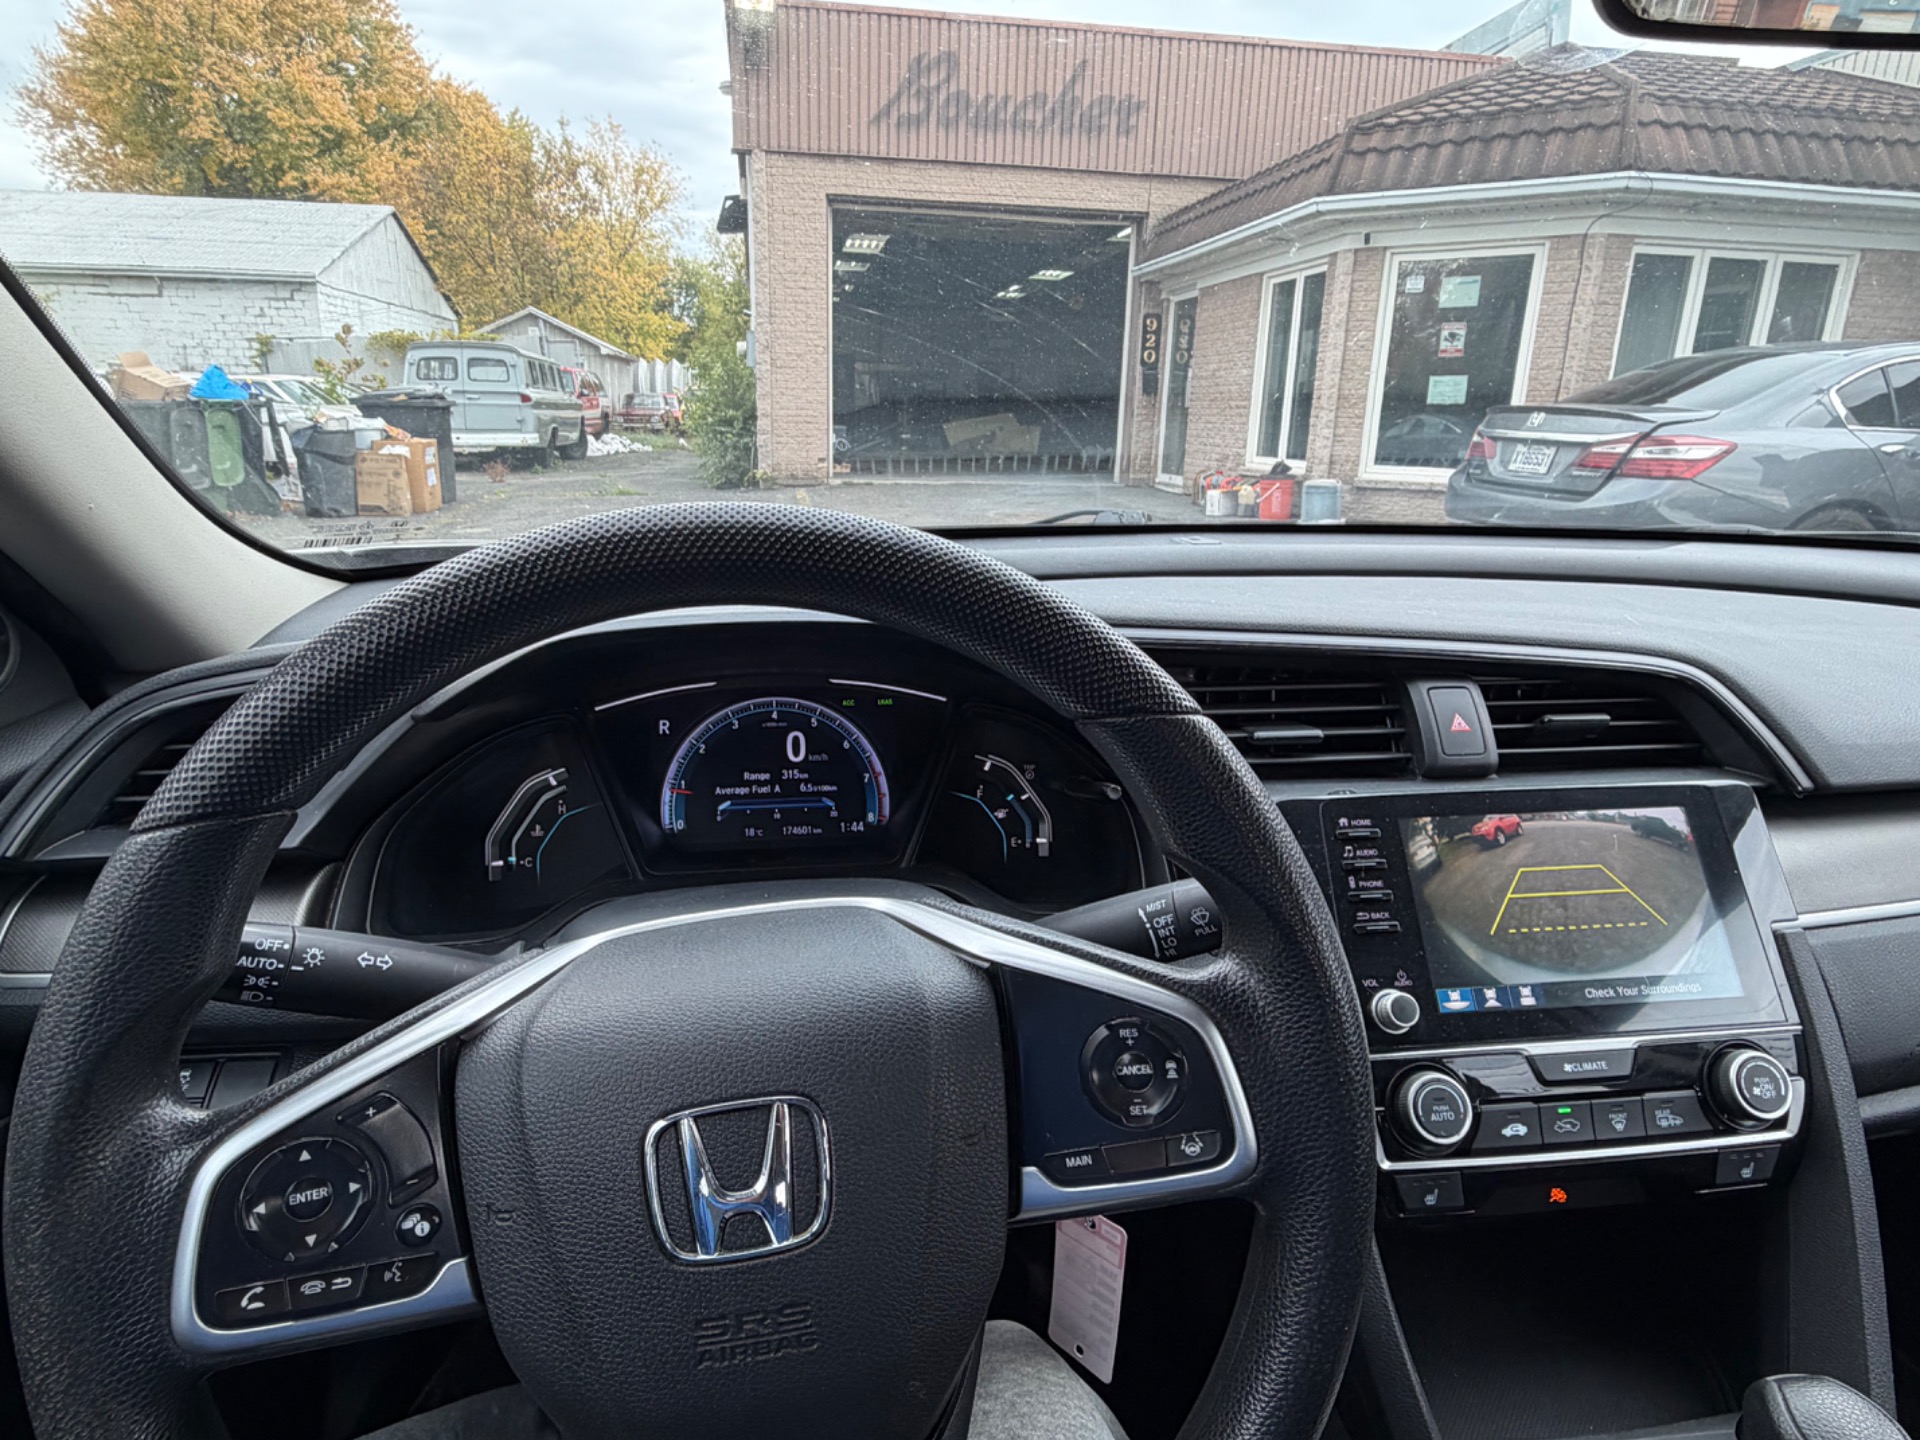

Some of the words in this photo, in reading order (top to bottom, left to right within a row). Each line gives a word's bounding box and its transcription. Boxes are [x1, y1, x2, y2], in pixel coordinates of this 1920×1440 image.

[870, 51, 1147, 137] Boucher
[1143, 317, 1159, 364] 920
[878, 698, 893, 706] LKAS
[771, 710, 778, 720] 4
[659, 719, 670, 735] R
[732, 720, 739, 730] 3
[810, 718, 818, 728] 5
[699, 744, 706, 754] 2
[786, 730, 806, 763] 0
[808, 753, 829, 761] km/h
[843, 740, 850, 749] 6
[743, 771, 771, 781] Range
[863, 773, 870, 783] 7
[680, 780, 685, 789] 1
[715, 786, 750, 796] Average
[752, 784, 771, 794] Fuel
[774, 783, 781, 793] A
[558, 804, 567, 815] H
[773, 812, 781, 820] 10
[867, 812, 875, 822] 8
[677, 820, 684, 830] 0
[840, 821, 864, 832] 1:44
[1351, 819, 1372, 827] HOME
[745, 828, 755, 837] 18
[782, 826, 812, 835] 174601
[1011, 837, 1018, 847] E
[1356, 848, 1378, 856] AUDIO
[525, 857, 533, 868] C
[1359, 880, 1384, 888] PHONE
[1146, 899, 1167, 913] MIST
[1153, 914, 1174, 928] OFF
[1157, 925, 1176, 938] INT
[1194, 924, 1218, 937] PULL
[255, 938, 284, 951] OFF
[1161, 937, 1177, 949] LO
[1163, 949, 1177, 958] HI
[236, 956, 277, 970] AUTO
[1361, 979, 1379, 988] VOL
[1585, 986, 1616, 998] Check
[1616, 985, 1639, 996] Your
[1641, 982, 1702, 995] Surroundings
[1119, 1028, 1138, 1038] RES
[1116, 1063, 1153, 1075] CANCEL
[1571, 1060, 1609, 1072] CLIMATE
[1129, 1105, 1148, 1116] SET
[1431, 1111, 1455, 1122] AUTO
[1066, 1155, 1092, 1168] MAIN
[288, 1186, 329, 1205] ENTER
[693, 1302, 812, 1344] SRS
[696, 1334, 818, 1369] AIRBAG
